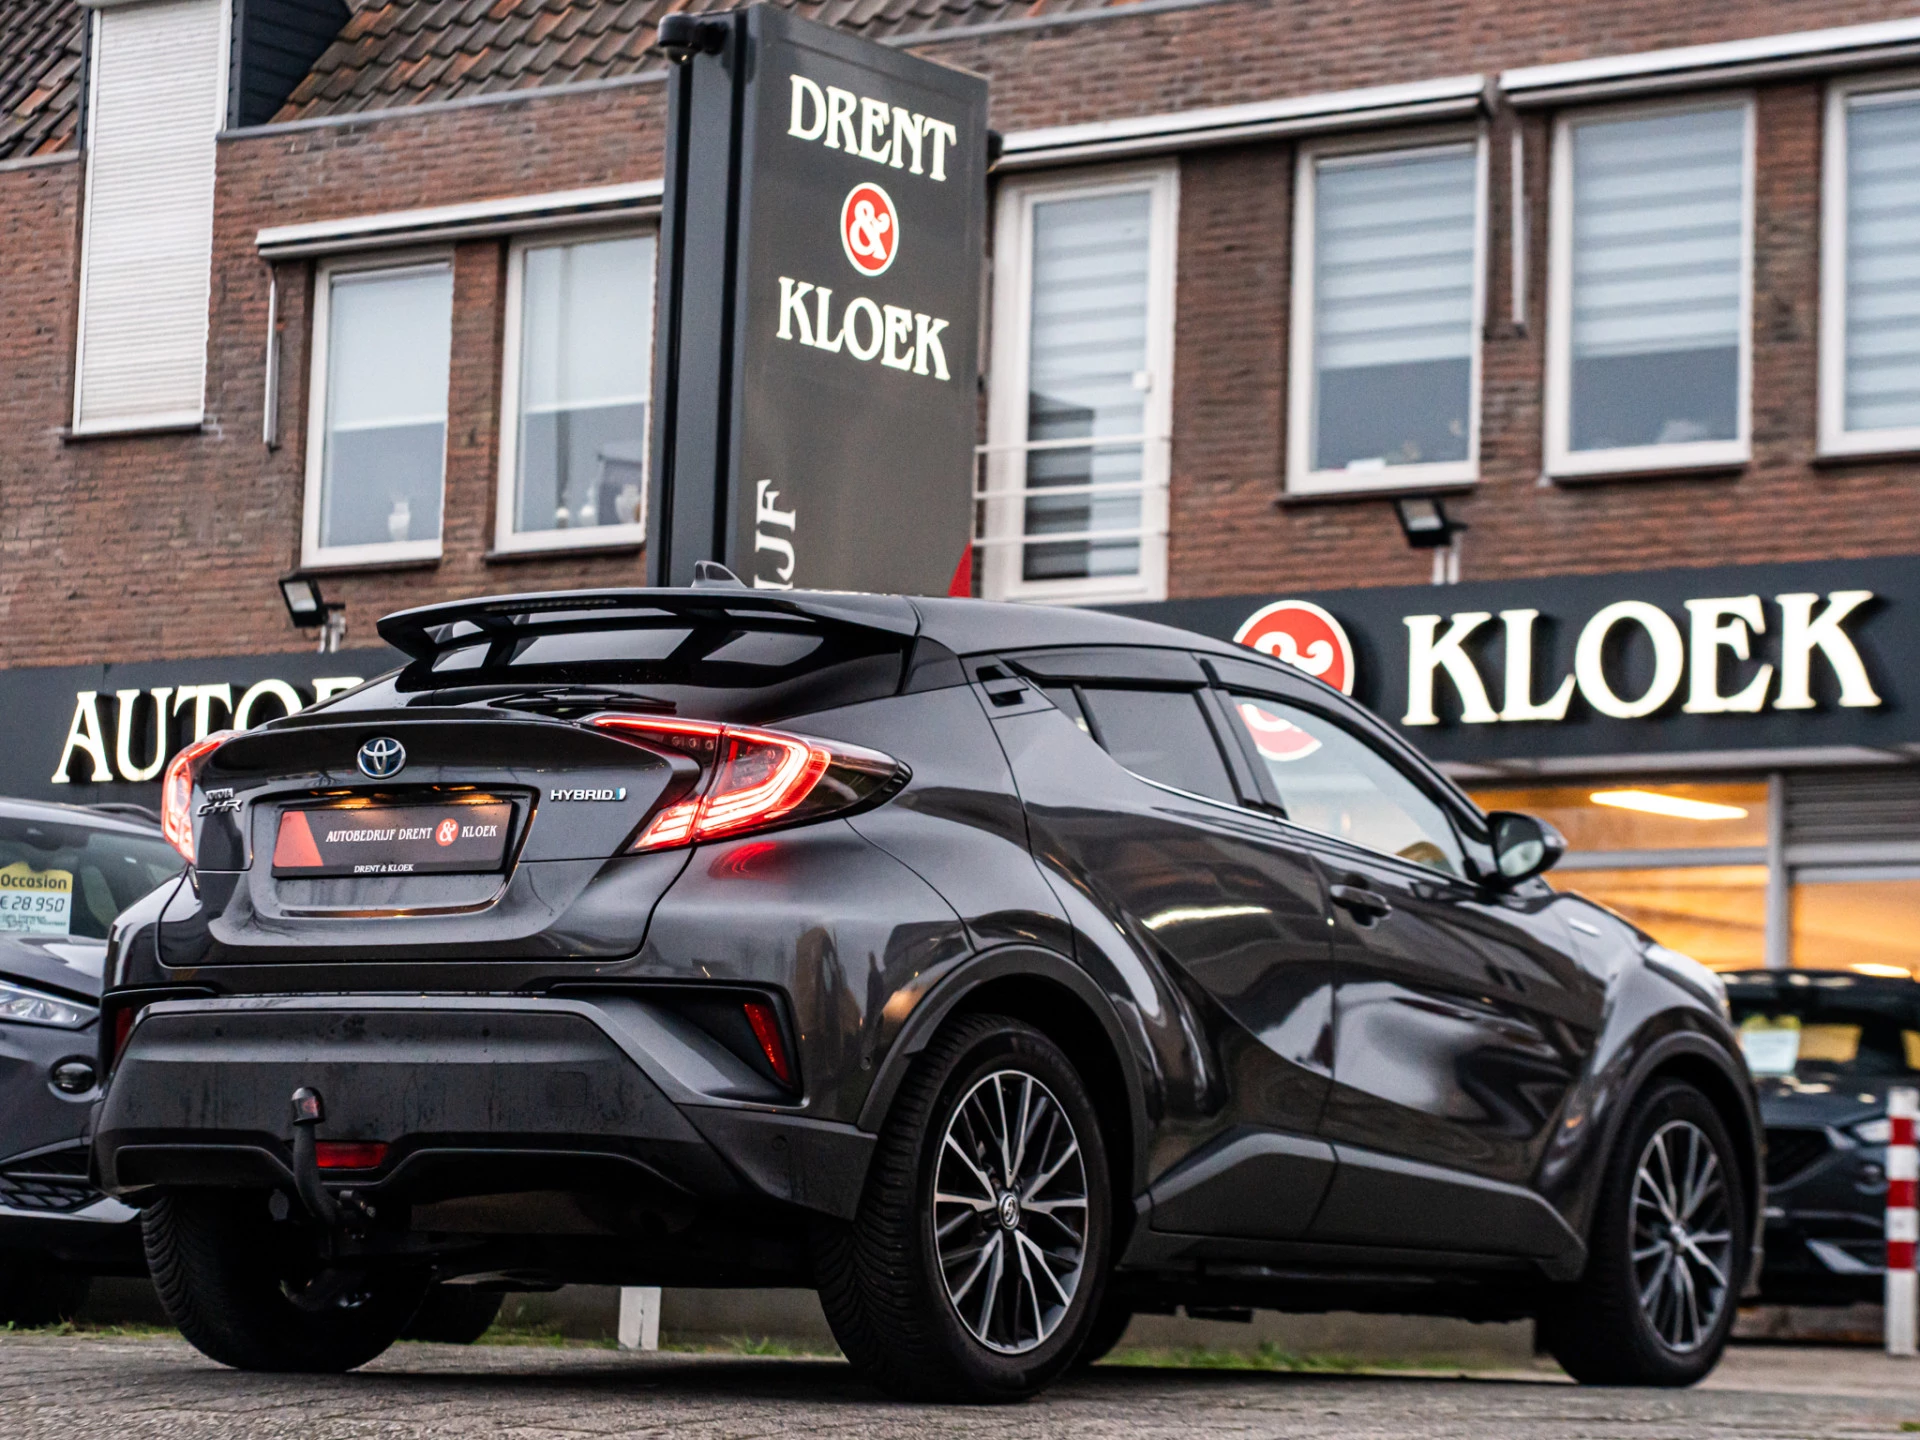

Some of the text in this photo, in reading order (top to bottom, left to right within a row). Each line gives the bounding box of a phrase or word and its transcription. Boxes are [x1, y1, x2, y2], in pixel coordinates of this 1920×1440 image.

[787, 73, 957, 182] DRENT
[847, 197, 893, 263] &
[776, 275, 951, 381] KLOEK
[1401, 590, 1882, 726] KLOEK
[51, 676, 366, 784] AUTO
[325, 821, 498, 843] AUTOBEDRIJF DRENT & KLOEK
[354, 863, 414, 873] DRENT & KLOEK
[0, 873, 68, 890] Occasion
